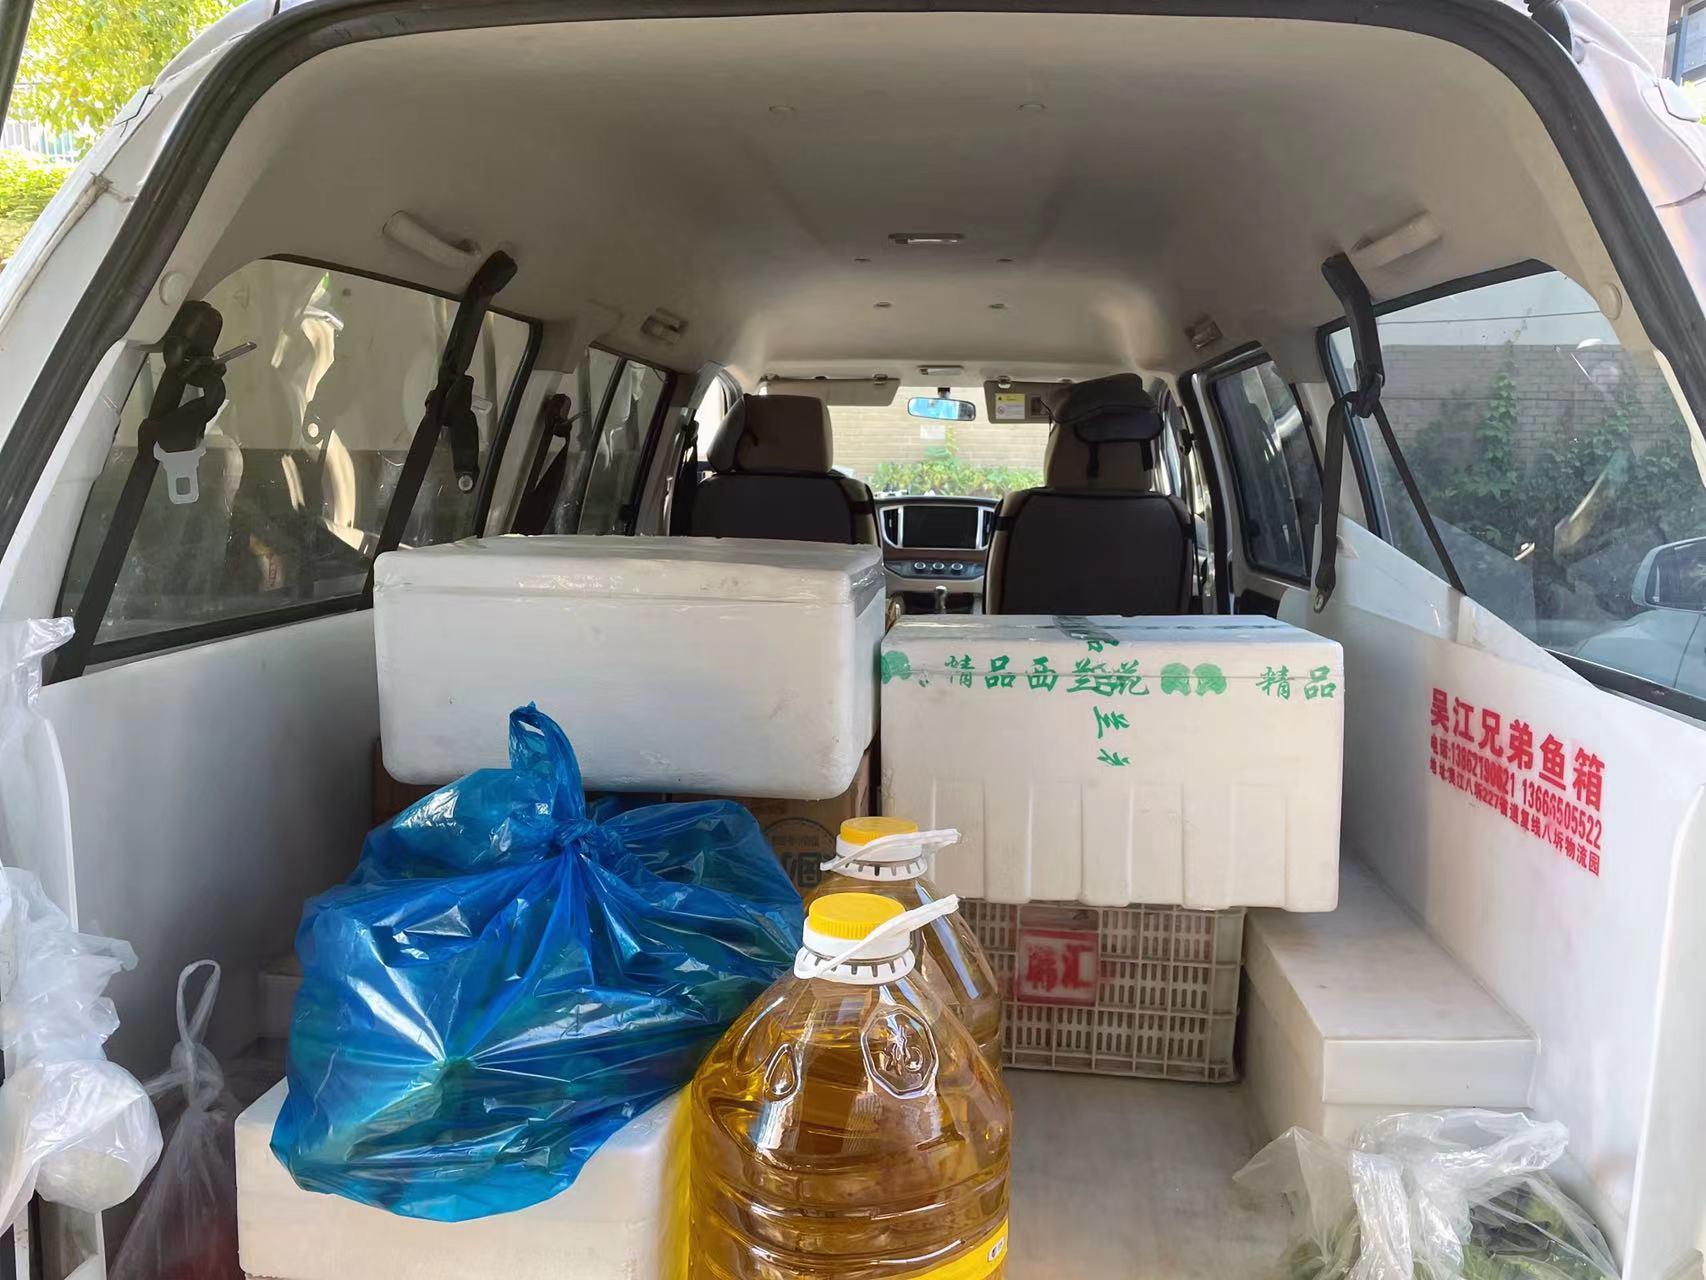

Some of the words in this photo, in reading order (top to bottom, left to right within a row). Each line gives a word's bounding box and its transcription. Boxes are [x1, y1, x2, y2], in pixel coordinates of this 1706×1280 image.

[1256, 665, 1336, 700] 精品
[1430, 687, 1605, 812] 吴江兄弟鱼箱
